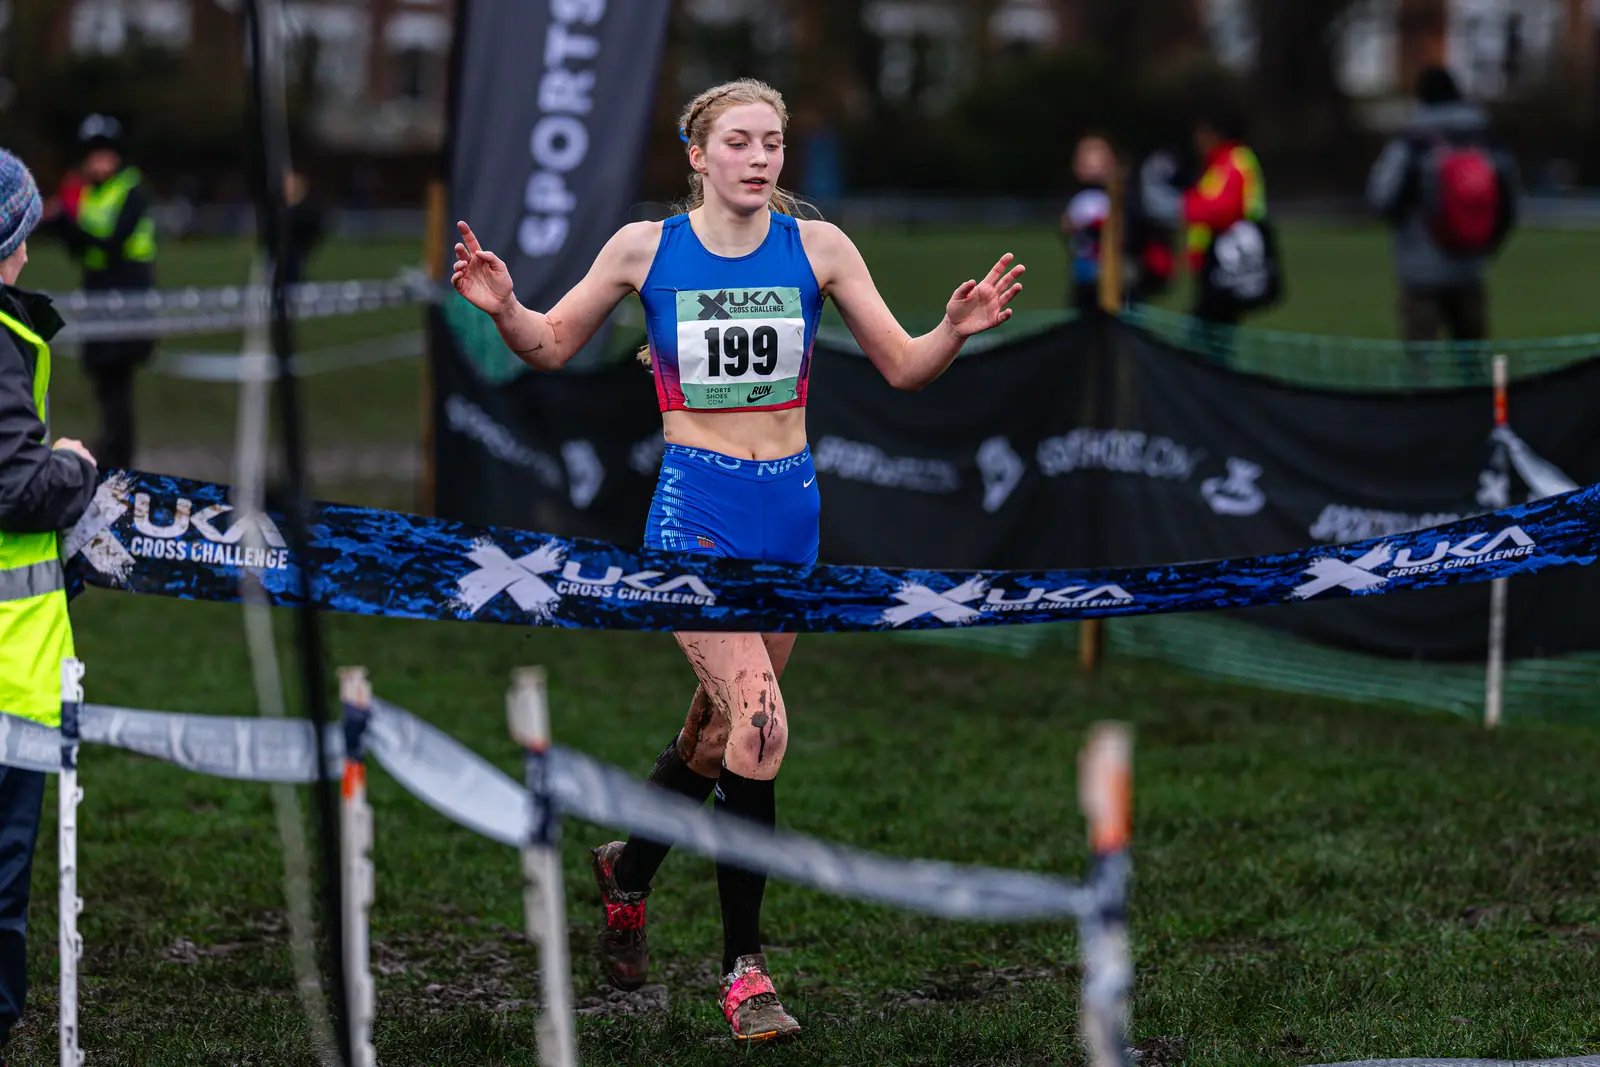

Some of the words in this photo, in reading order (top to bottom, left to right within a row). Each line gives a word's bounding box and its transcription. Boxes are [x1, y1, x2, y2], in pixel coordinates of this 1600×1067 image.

[728, 291, 784, 305] UKA
[729, 306, 749, 314] CROSS
[750, 305, 785, 313] CHALLENGE
[704, 325, 778, 377] 199
[752, 385, 772, 395] RUN
[133, 492, 288, 548] UKA
[131, 536, 187, 561] CROSS
[190, 543, 289, 570] CHALLENGE
[1393, 525, 1536, 568] UKA
[1387, 563, 1440, 579] CROSS
[1443, 544, 1536, 569] CHALLENGE
[556, 581, 613, 598] CROSS
[616, 587, 717, 606] CHALLENGE
[561, 561, 717, 597] UKA
[979, 601, 1034, 613] CROSS
[1037, 597, 1134, 610] CHALLENGE
[985, 584, 1135, 604] UKA
